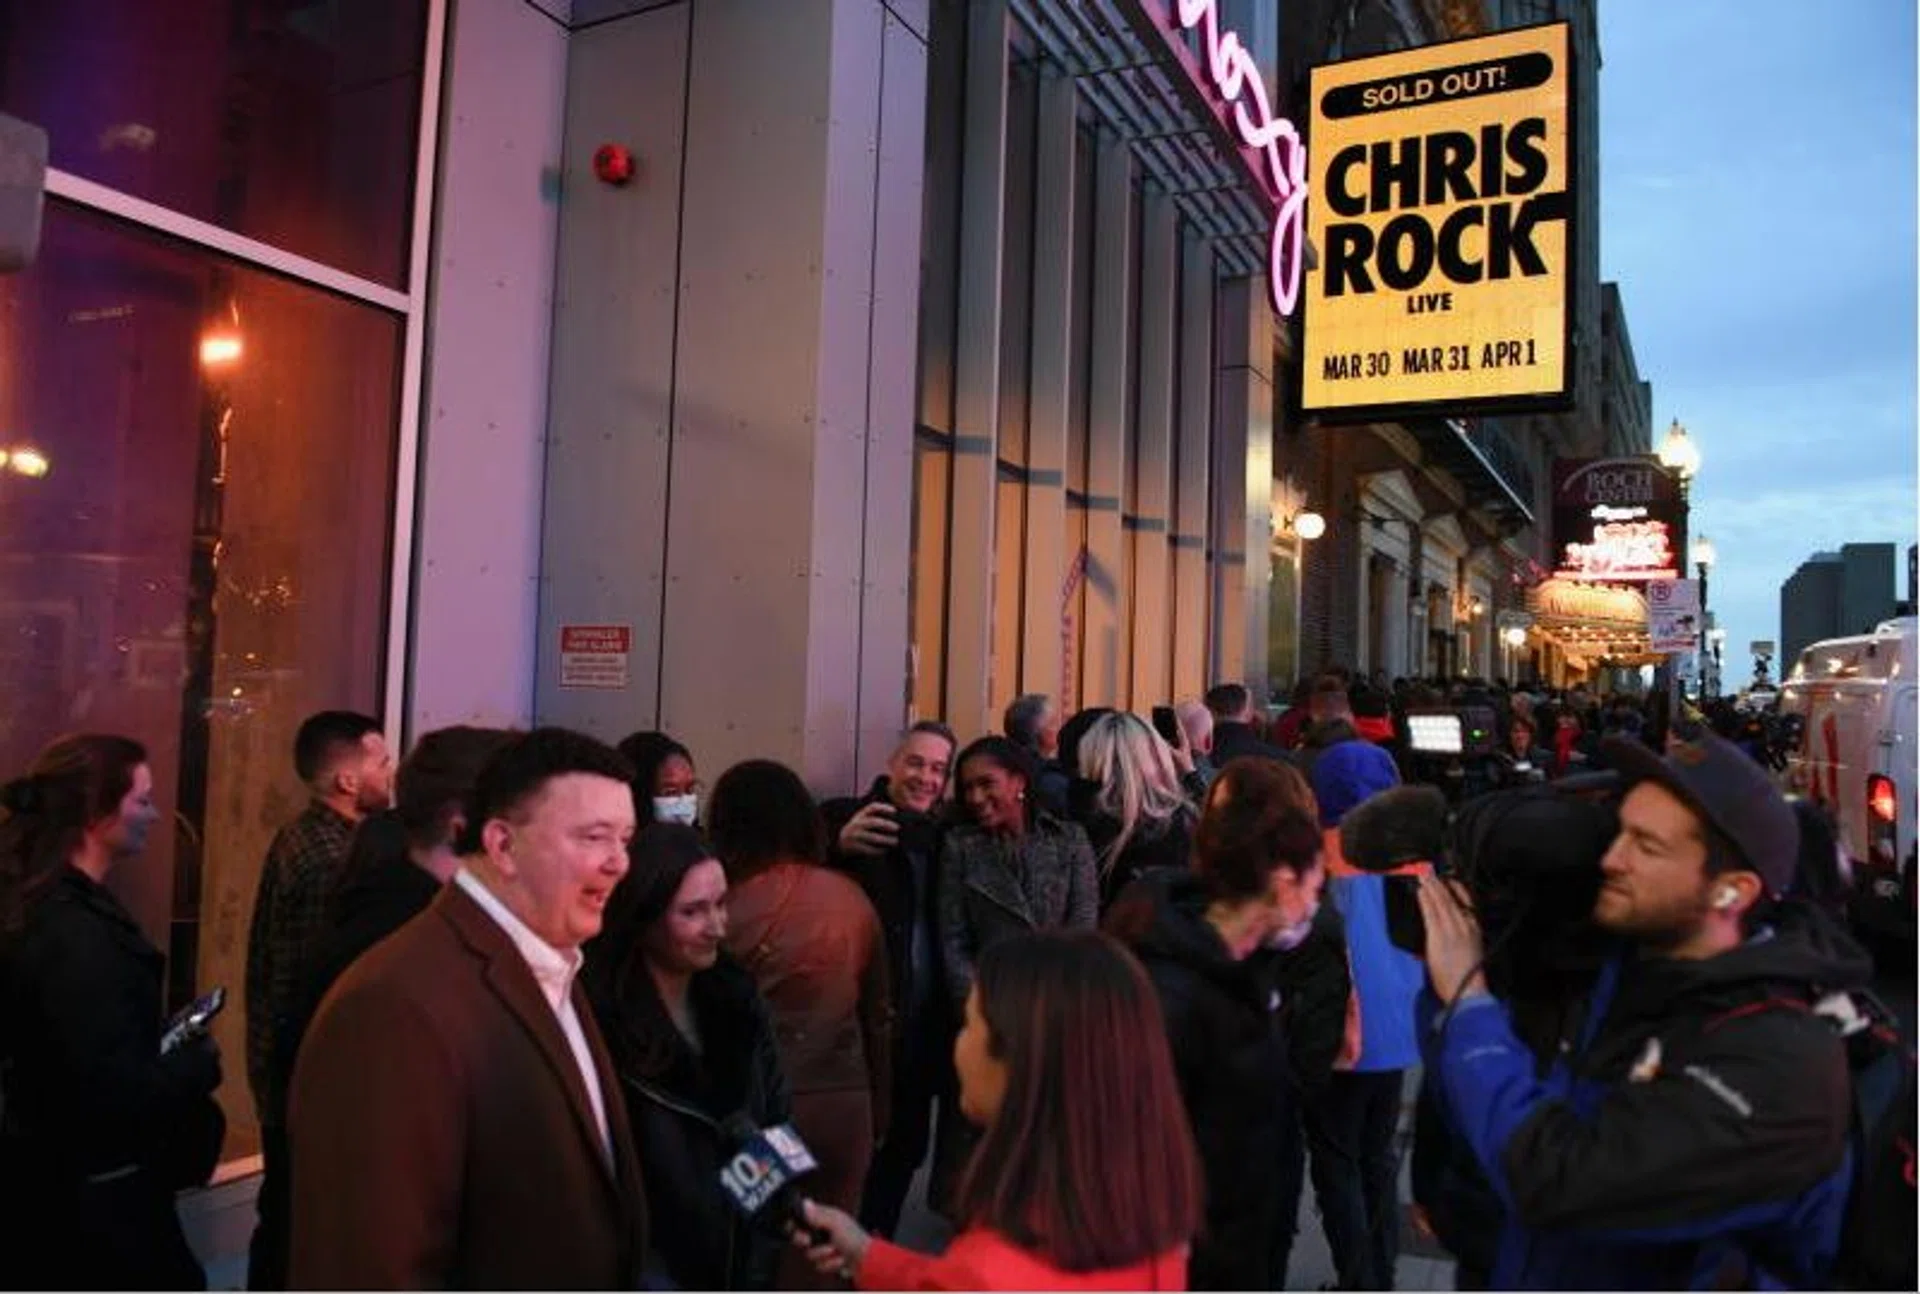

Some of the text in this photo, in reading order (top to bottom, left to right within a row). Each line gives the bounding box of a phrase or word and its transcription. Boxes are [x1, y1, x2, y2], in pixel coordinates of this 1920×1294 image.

[1362, 65, 1507, 109] SOLD OUT!
[1325, 118, 1549, 217] CHRIS
[1324, 193, 1567, 298] ROCK
[1406, 292, 1454, 315] LIVE
[1323, 338, 1537, 380] MAR 30 MAR 31 APR 1
[720, 1152, 763, 1200] 10
